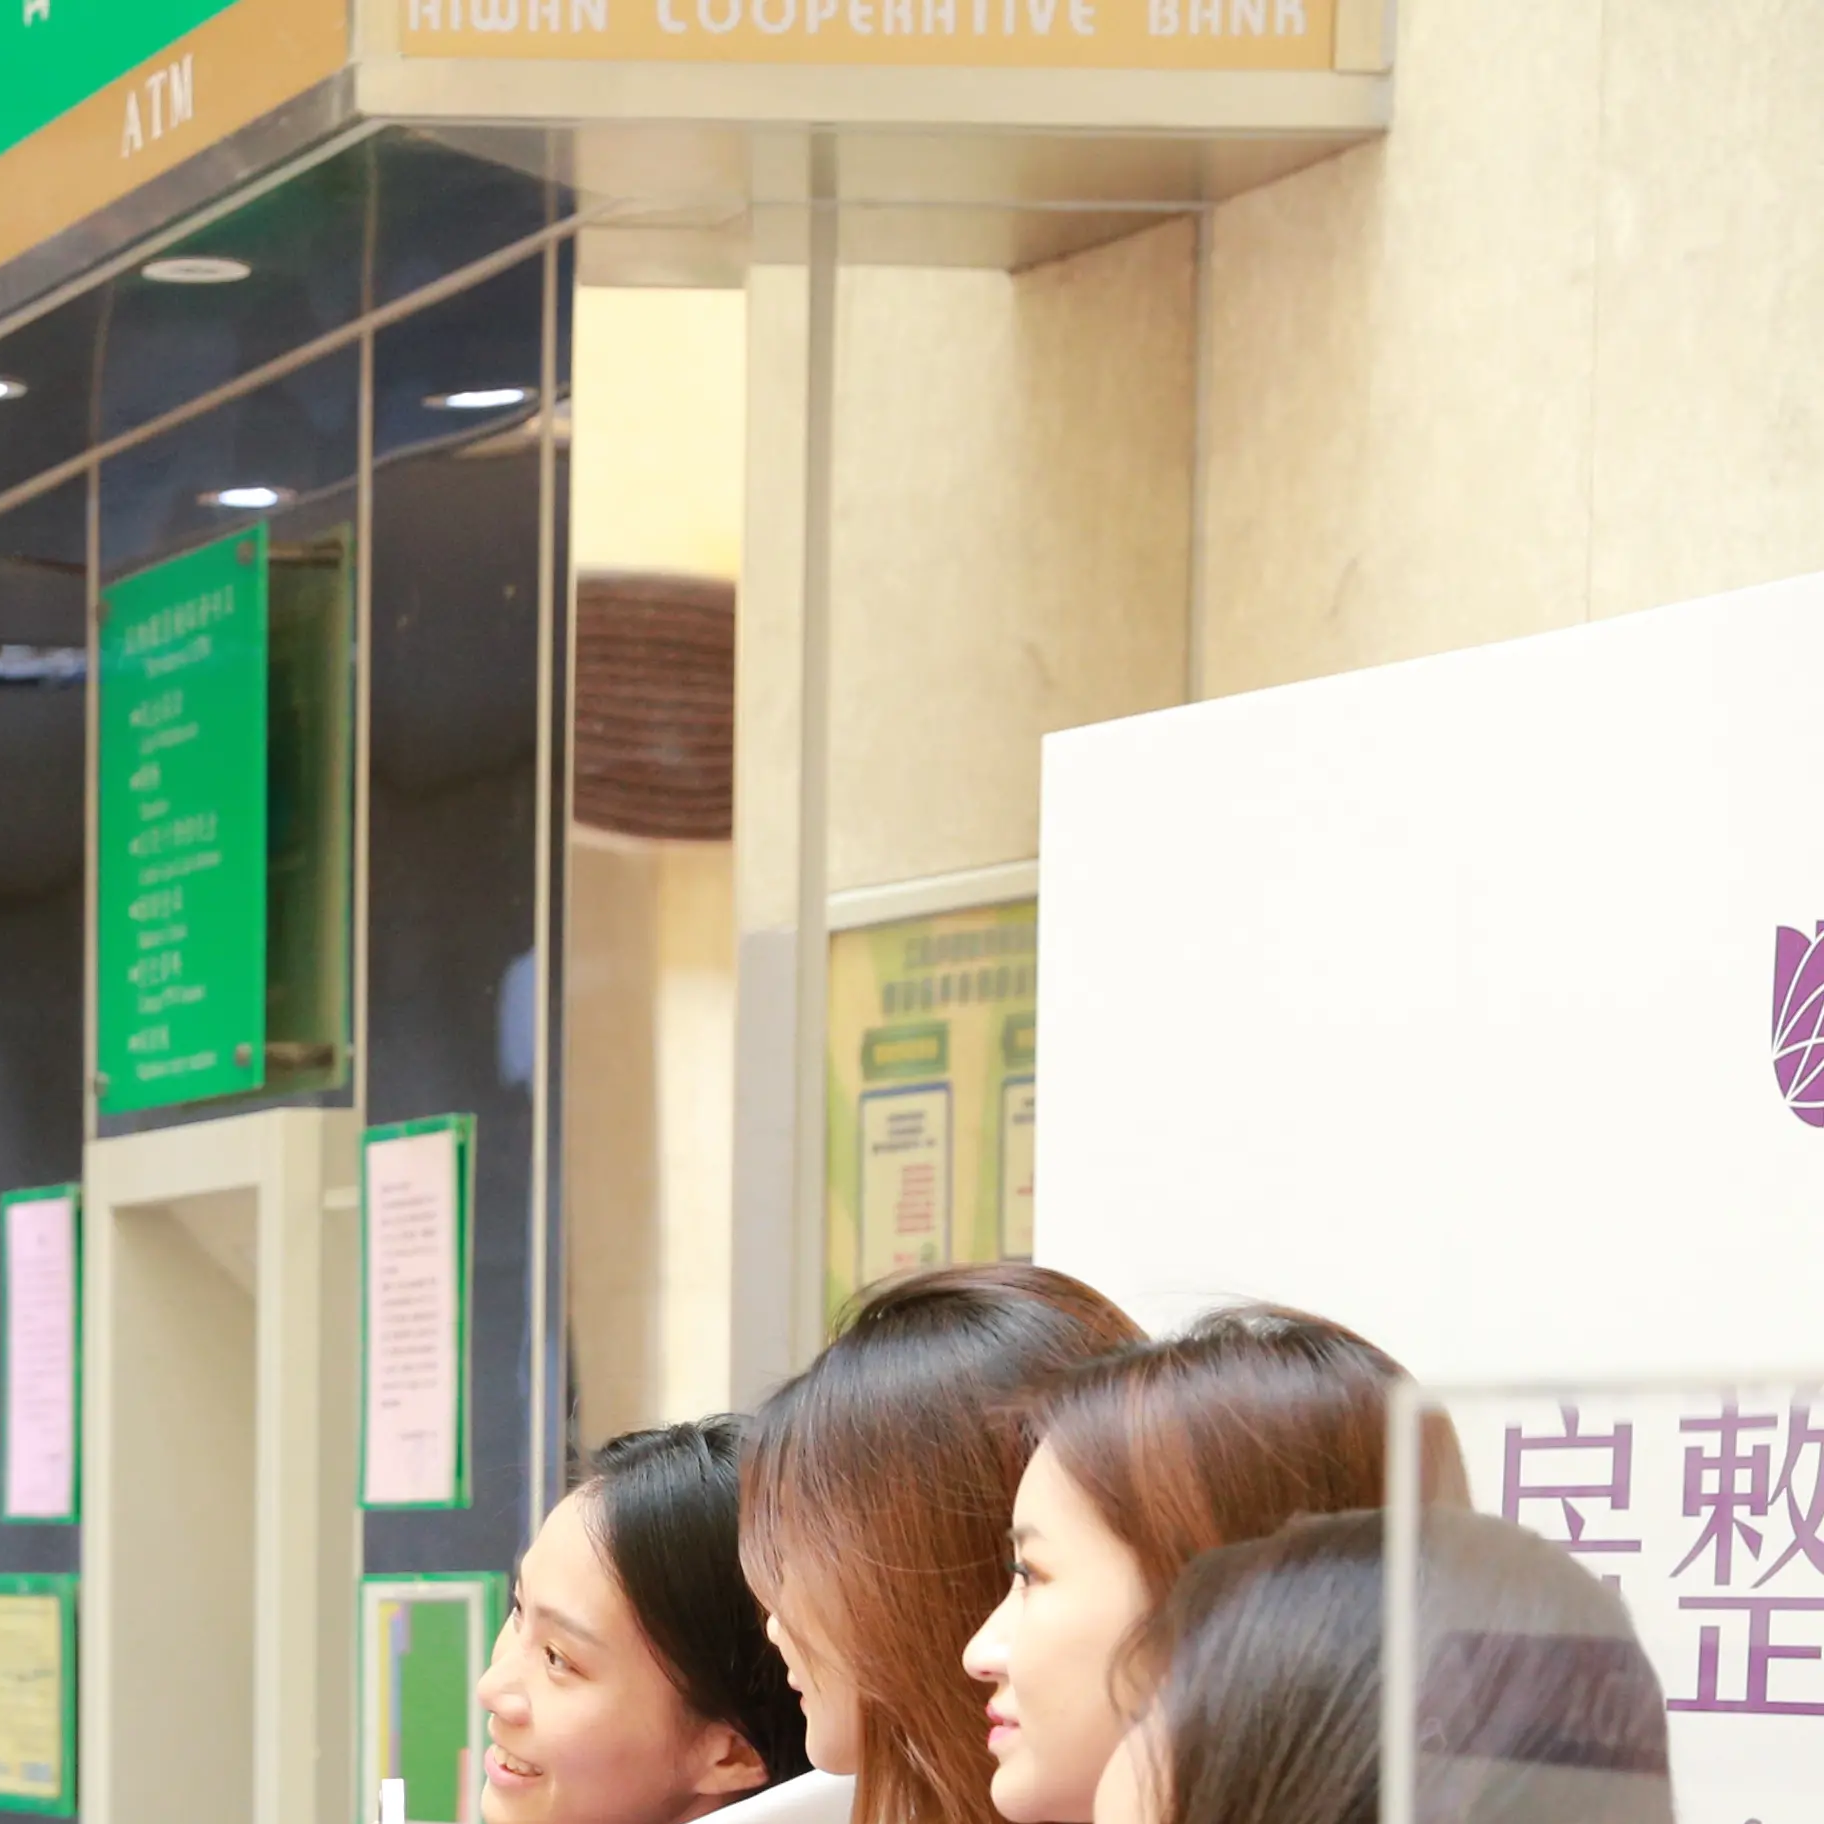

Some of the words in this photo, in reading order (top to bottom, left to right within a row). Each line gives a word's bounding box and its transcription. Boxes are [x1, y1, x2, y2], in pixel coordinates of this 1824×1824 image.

[655, 0, 1097, 37] COOPERATIVE
[1148, 0, 1307, 37] BANK
[121, 53, 195, 158] ATM
